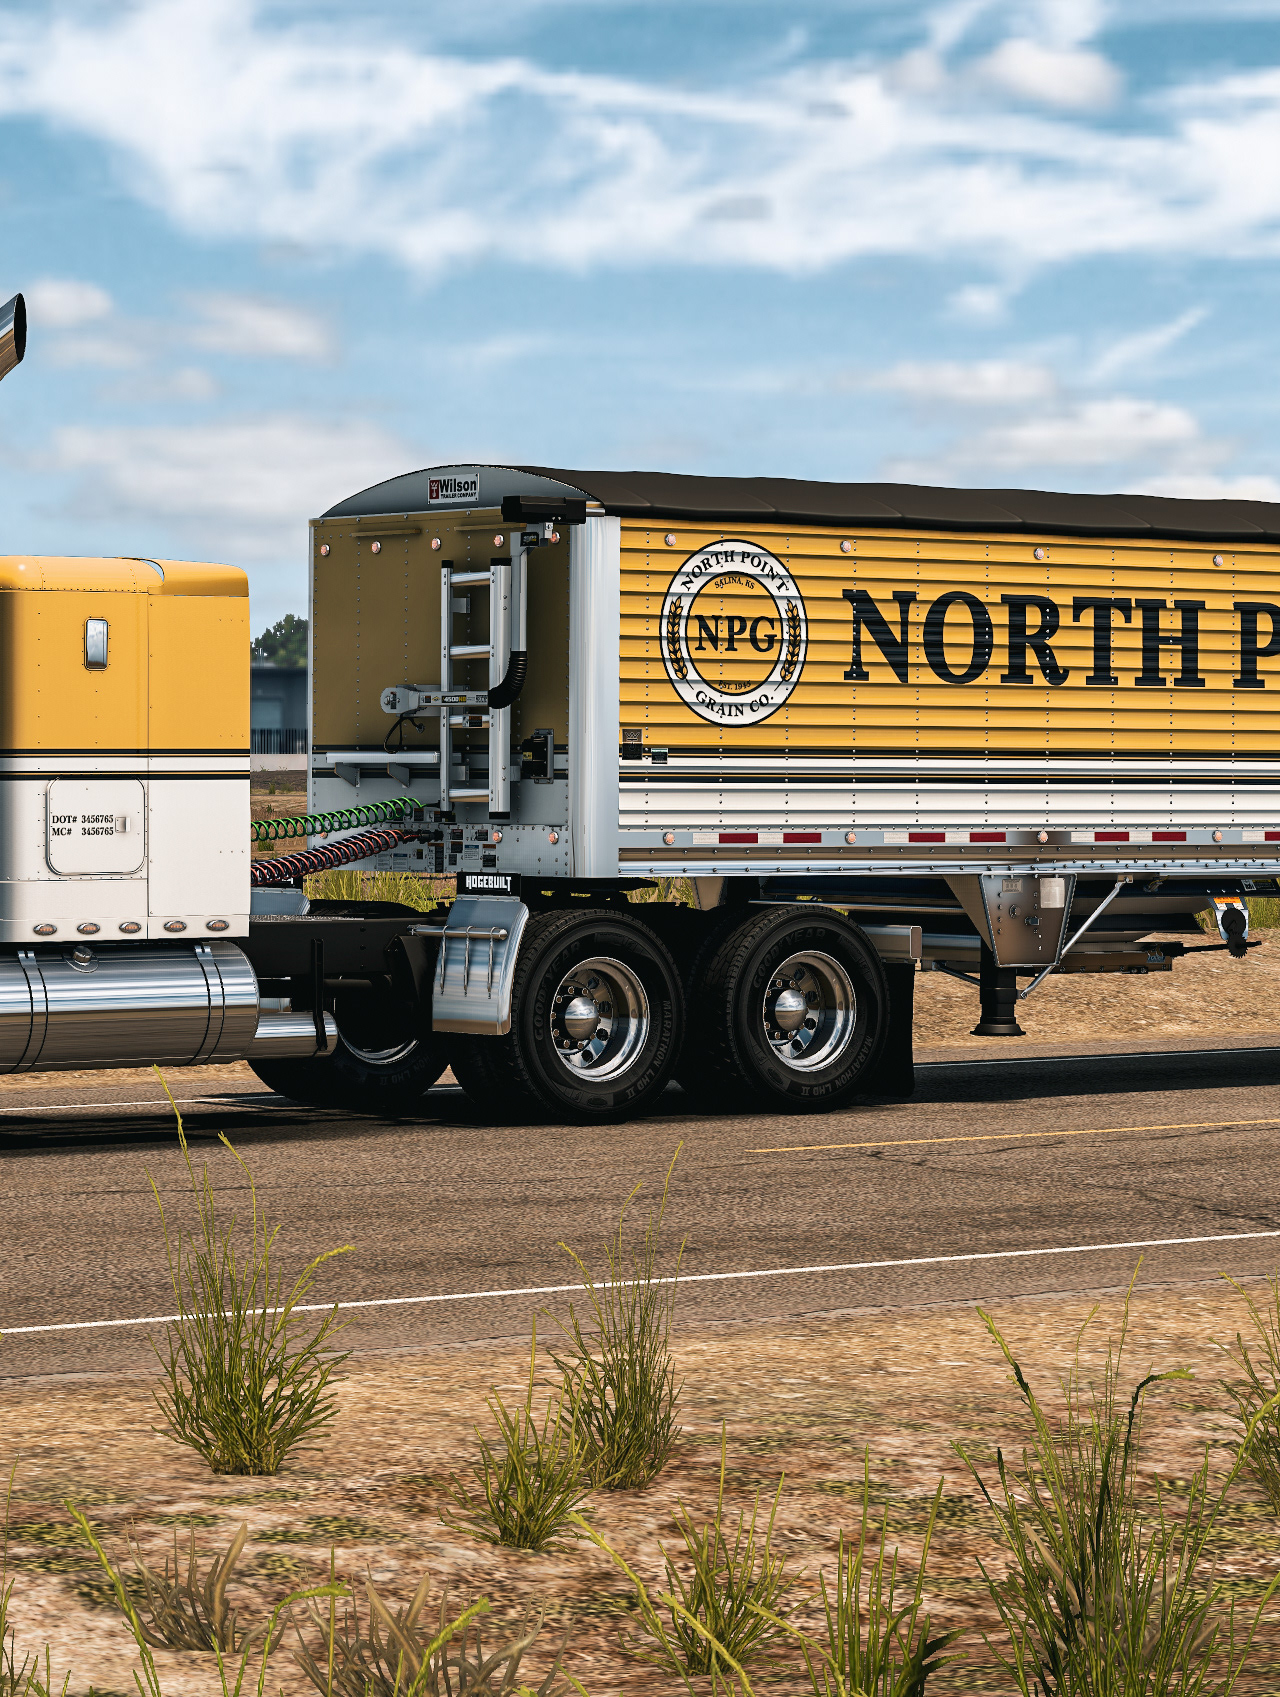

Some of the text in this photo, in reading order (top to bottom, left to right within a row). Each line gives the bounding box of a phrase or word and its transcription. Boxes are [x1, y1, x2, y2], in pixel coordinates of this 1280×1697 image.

[440, 478, 477, 493] Wilson
[680, 549, 790, 592] NORTH POINT
[745, 579, 756, 589] KS
[694, 614, 778, 653] NPG
[842, 588, 1206, 687] NORTH
[695, 690, 774, 717] GRAIN CO.
[52, 814, 114, 824] DOT# 3456765
[52, 826, 114, 836] MC# 3456765
[465, 875, 512, 892] HOGEBUILT
[652, 999, 672, 1068] MARATHON
[835, 1035, 874, 1089] MARATHON
